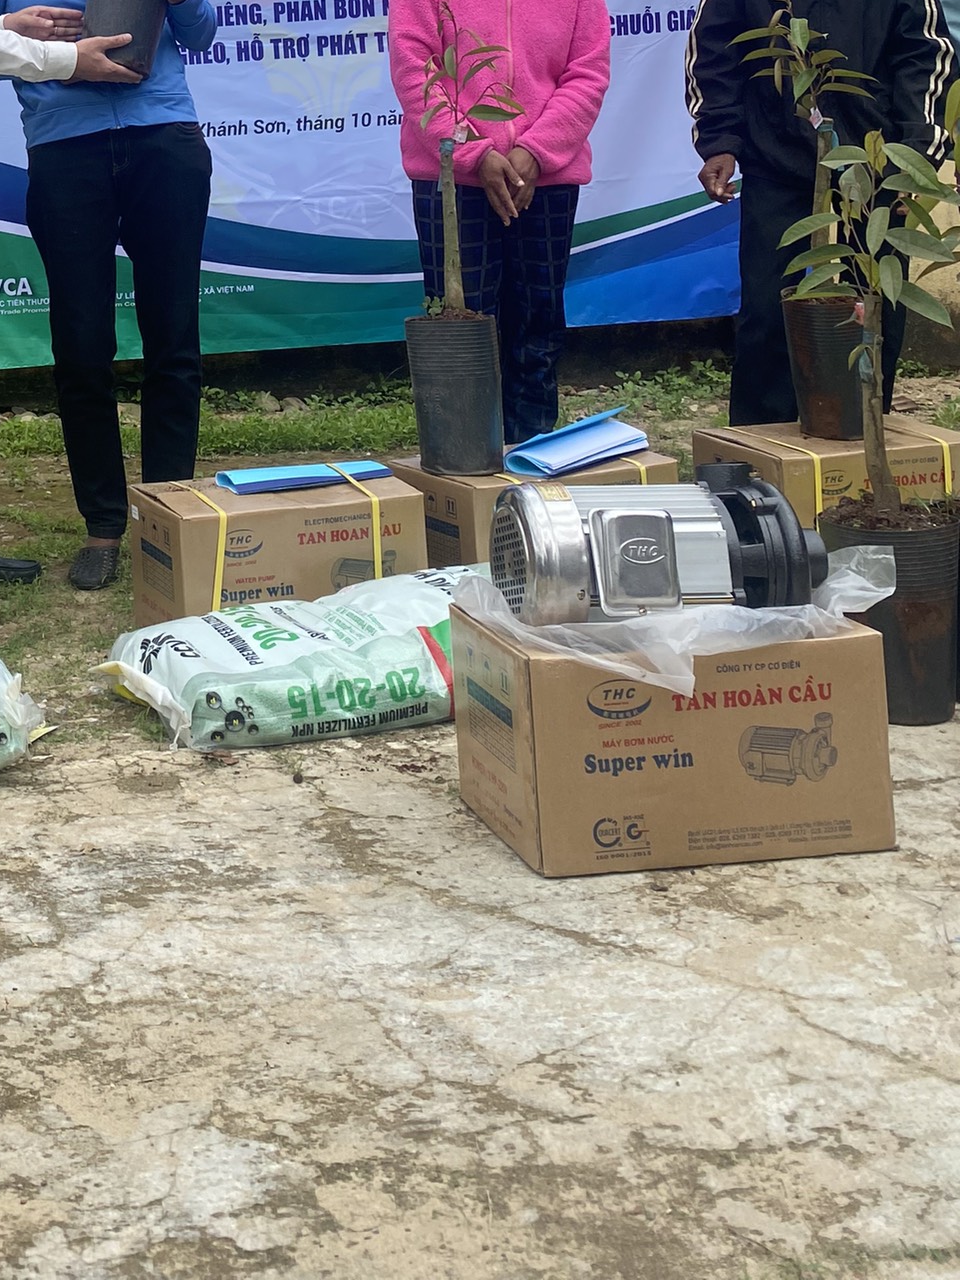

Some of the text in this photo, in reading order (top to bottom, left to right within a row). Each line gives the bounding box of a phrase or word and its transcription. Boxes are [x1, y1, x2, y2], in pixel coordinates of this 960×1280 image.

[216, 1, 267, 27] IÊNG,
[237, 33, 265, 62] HỖ
[270, 33, 310, 62] TRỢ
[317, 30, 369, 57] PHÁT
[253, 119, 291, 136] Sơn,
[296, 115, 345, 133] tháng
[351, 112, 372, 128] 10
[26, 297, 50, 306] THƯƠ
[236, 284, 255, 292] NAM
[825, 475, 844, 483] THC
[304, 513, 372, 526] ELECTROMECHANICS
[229, 535, 252, 546] THC
[297, 531, 327, 545] TAN
[330, 527, 369, 542] HOAN
[629, 545, 658, 557] THC
[220, 582, 294, 604] Super win
[716, 663, 740, 674] CÔNG
[743, 663, 753, 672] TY
[754, 662, 766, 671] CP
[287, 666, 426, 719] 20-20-15
[603, 687, 636, 700] THC
[723, 683, 782, 709] HOÀN
[788, 674, 832, 703] CẦU
[291, 702, 429, 738] PREMIUM FERTILIZER NPK
[602, 734, 675, 749] MÁY BƠM NƯỚC
[584, 748, 694, 777] Super win
